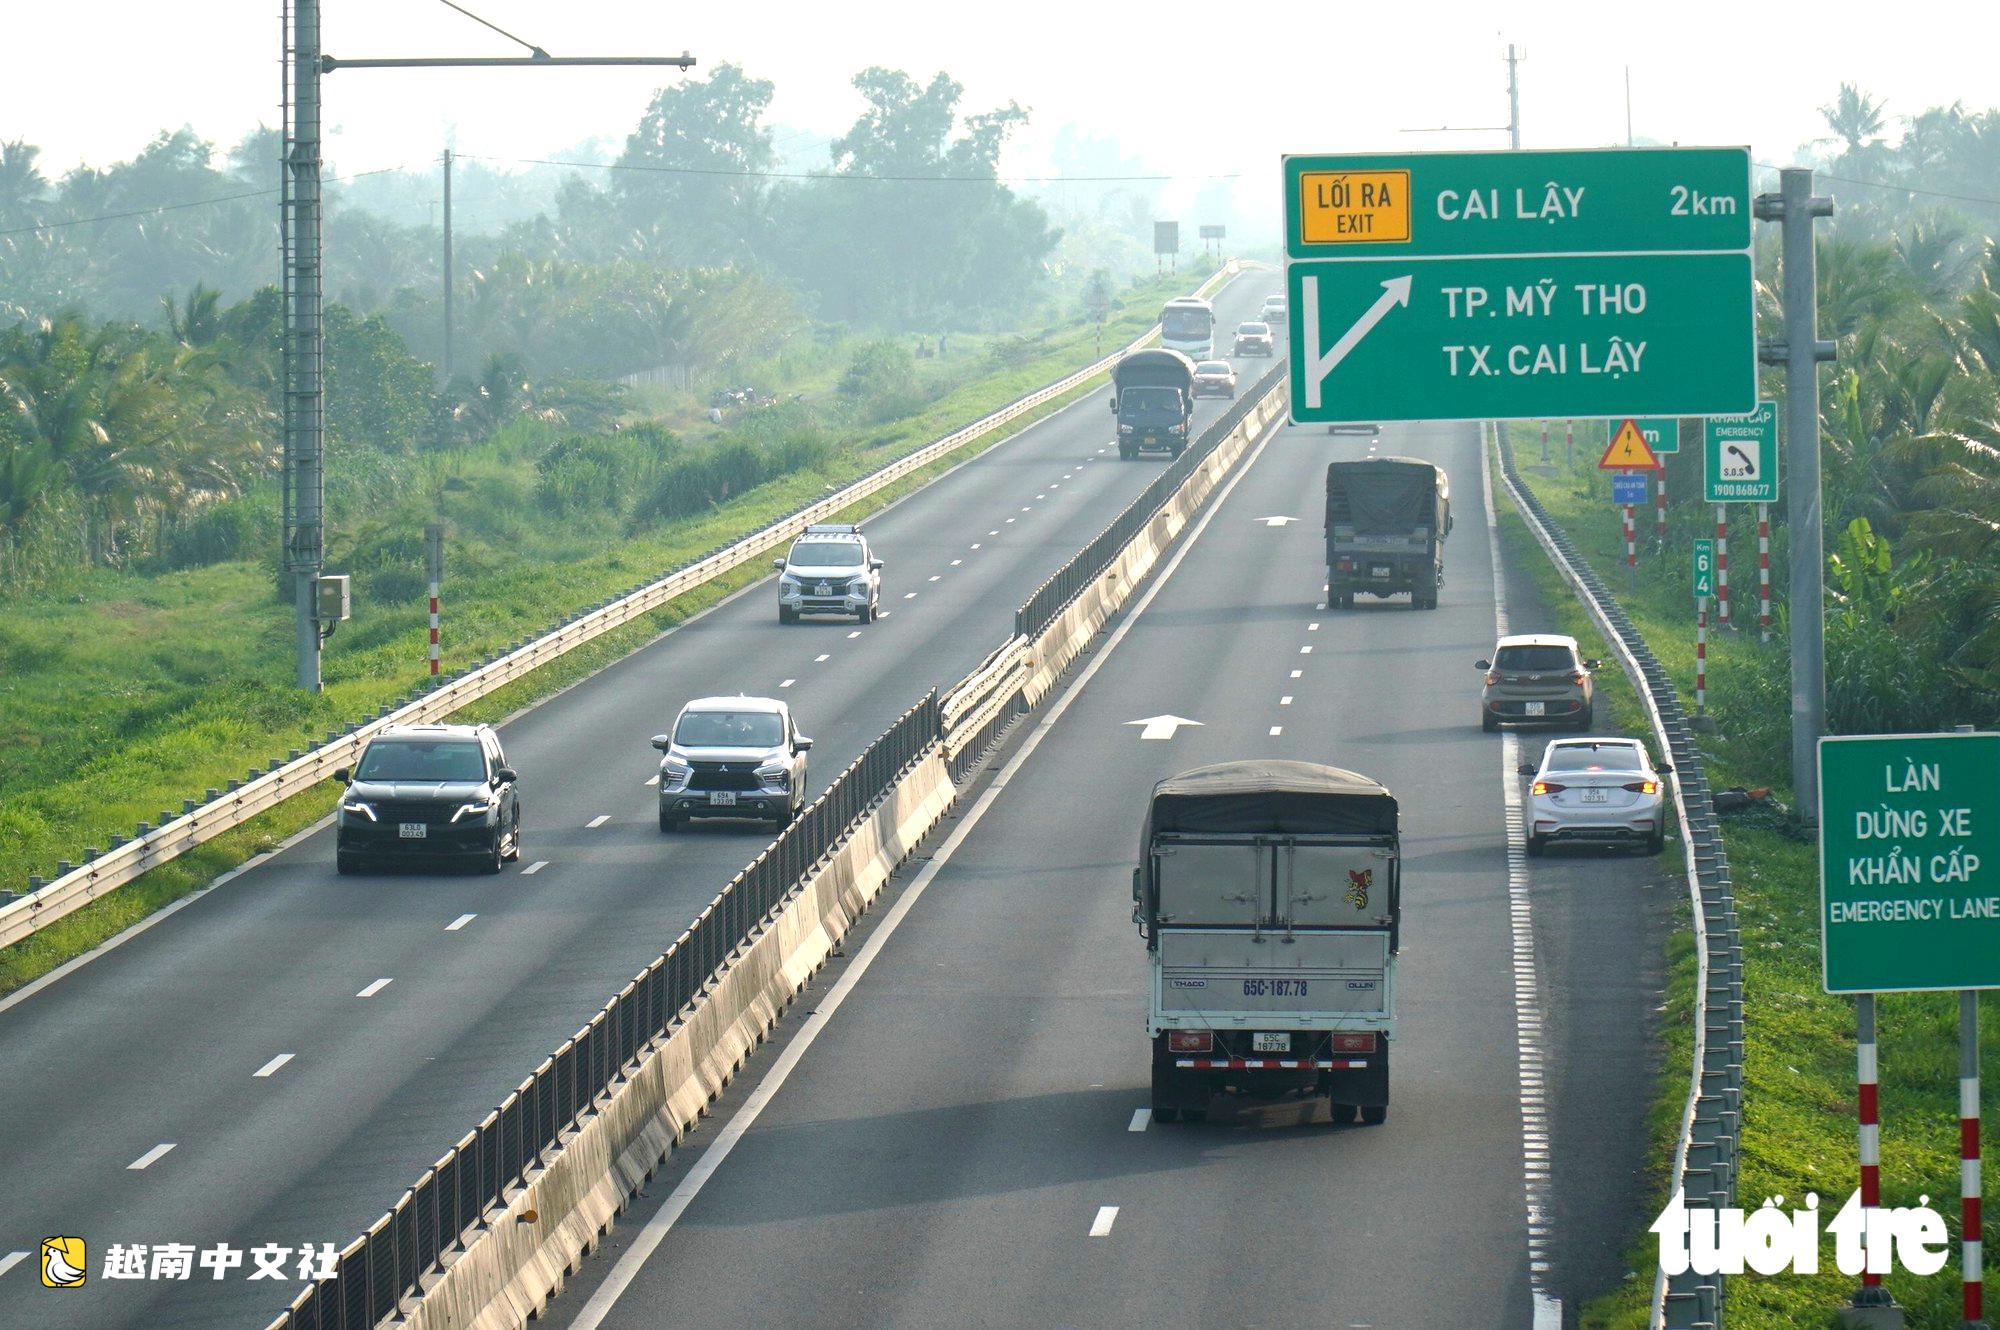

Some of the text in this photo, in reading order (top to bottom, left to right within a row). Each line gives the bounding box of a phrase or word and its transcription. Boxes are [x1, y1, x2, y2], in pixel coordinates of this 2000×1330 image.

[1317, 175, 1392, 208] LỐI RA
[1436, 181, 1586, 224] CAI LẬY
[1669, 185, 1737, 216] 2km
[1336, 213, 1375, 234] EXIT
[1574, 282, 1647, 316] THO
[1580, 335, 1647, 379] LẬY
[1715, 427, 1765, 437] EMERGENCY
[1723, 467, 1744, 477] S.O.S
[1713, 483, 1770, 496] 1900 868677
[1885, 756, 1940, 793] LÀN
[1855, 803, 1972, 840] DỪNG XE
[1849, 845, 1980, 885] KHẨN CẤP
[1830, 897, 2000, 923] EMERGENCY LANE
[1173, 980, 1205, 988] THACO
[1242, 980, 1308, 997] 65C-187.78
[1263, 1033, 1280, 1042] 65C
